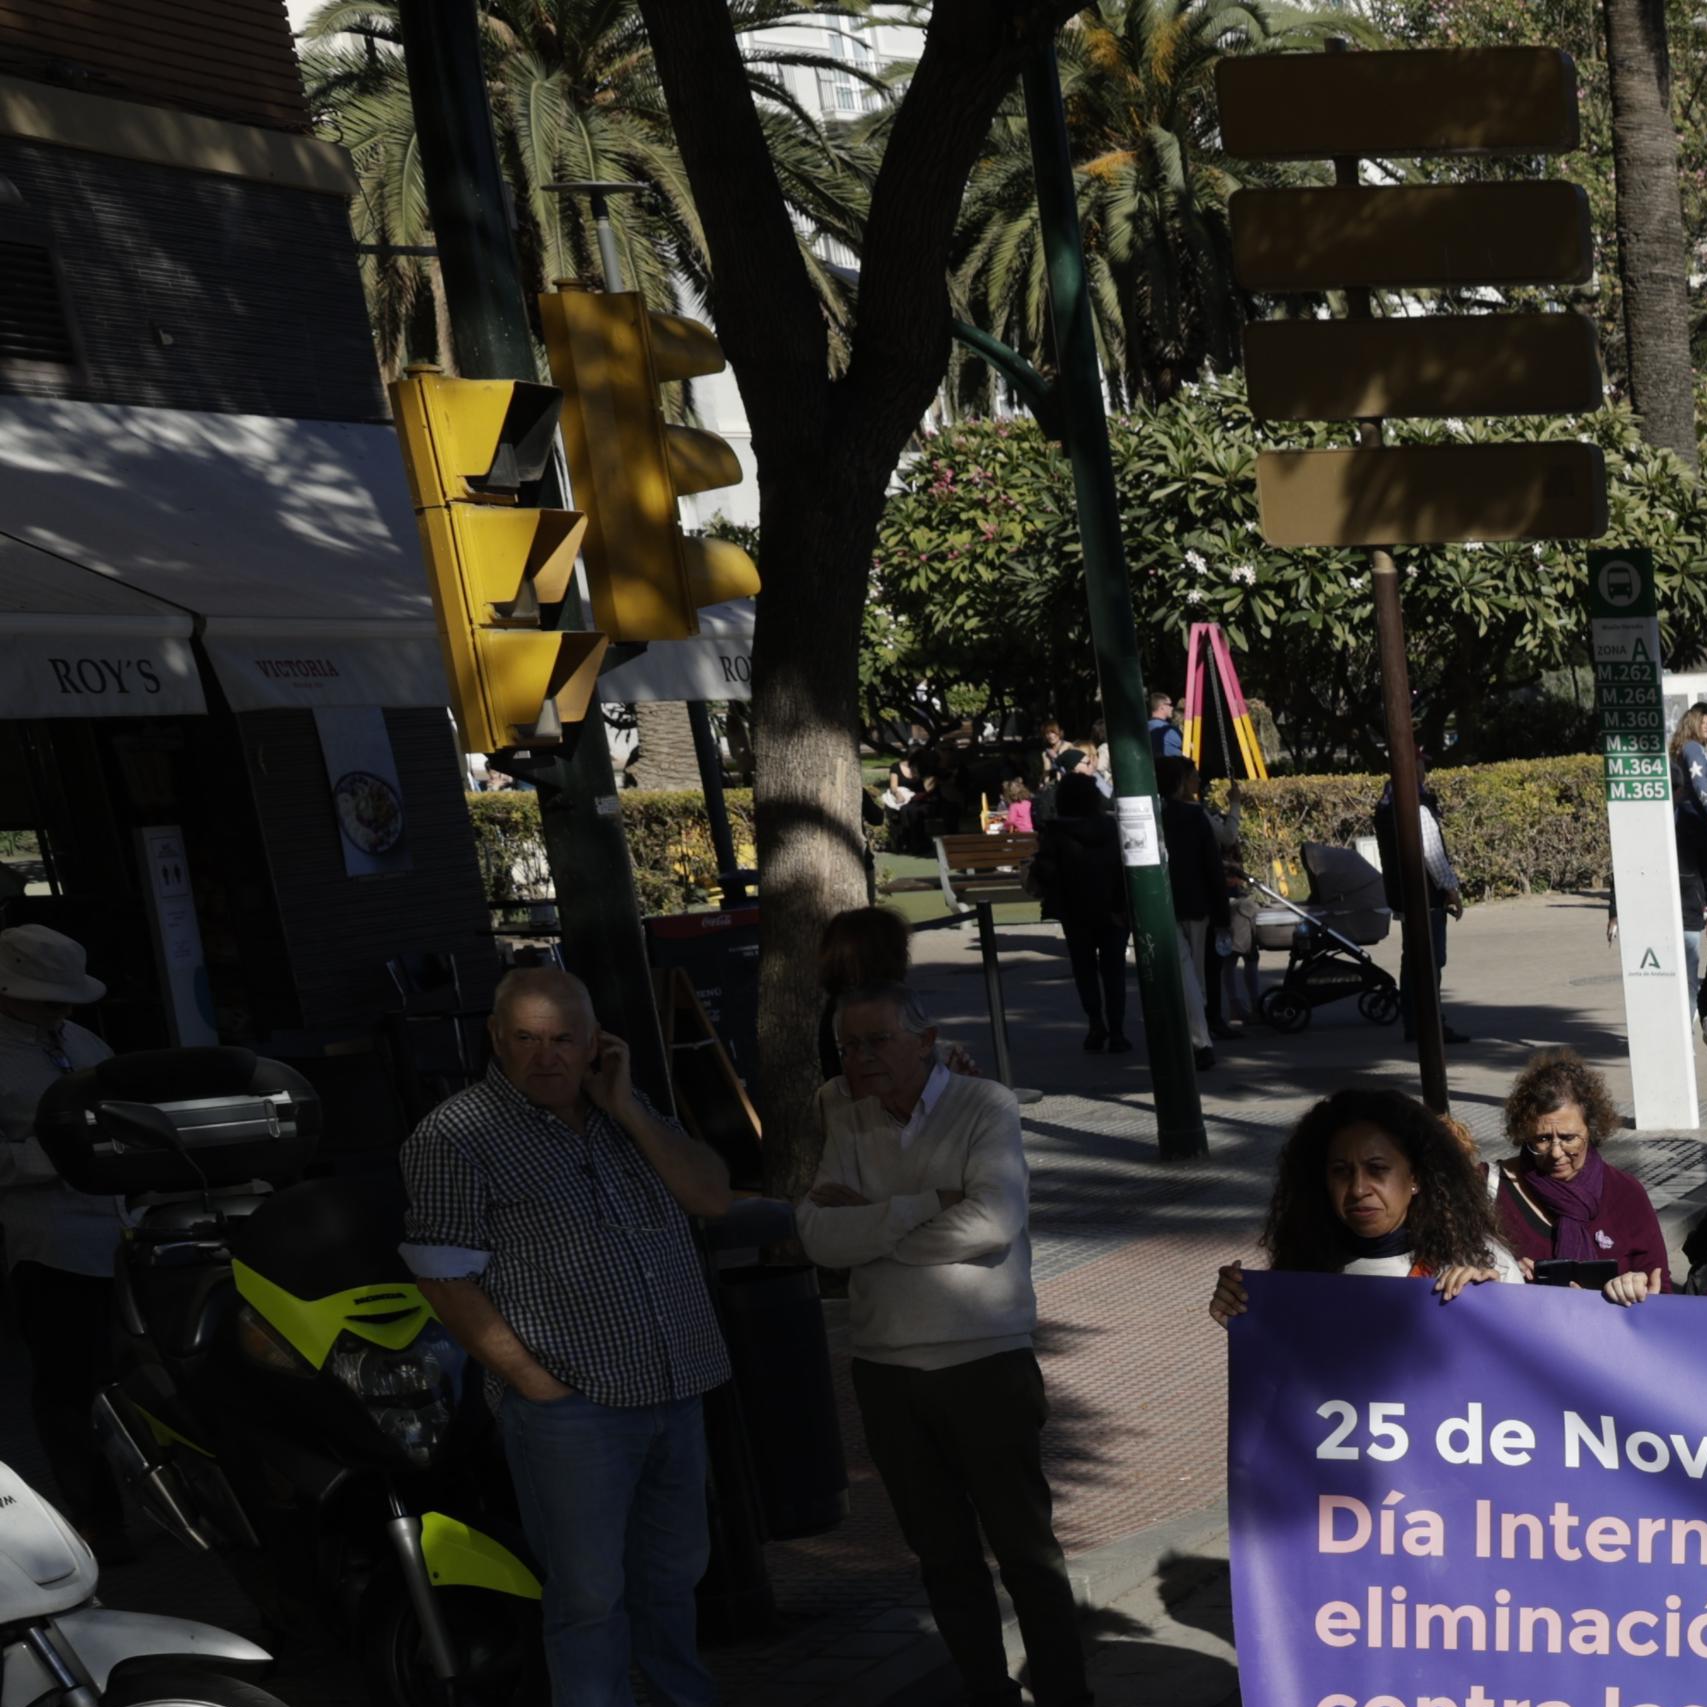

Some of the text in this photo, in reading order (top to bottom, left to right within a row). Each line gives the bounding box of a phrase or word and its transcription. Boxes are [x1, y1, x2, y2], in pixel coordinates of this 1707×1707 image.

[1597, 638, 1649, 661] ZONA A
[256, 660, 339, 677] VICTORIA
[720, 656, 751, 682] RO
[1598, 664, 1651, 681] M.262
[1602, 687, 1657, 704] M.264
[1604, 711, 1658, 728] M.360
[1606, 734, 1660, 752] M.363
[1608, 757, 1663, 775] M.364
[1610, 781, 1665, 799] M.365
[353, 1292, 407, 1305] HONDA
[1316, 1400, 1409, 1461] 25
[1436, 1402, 1536, 1466] de
[1317, 1491, 1445, 1556] Día
